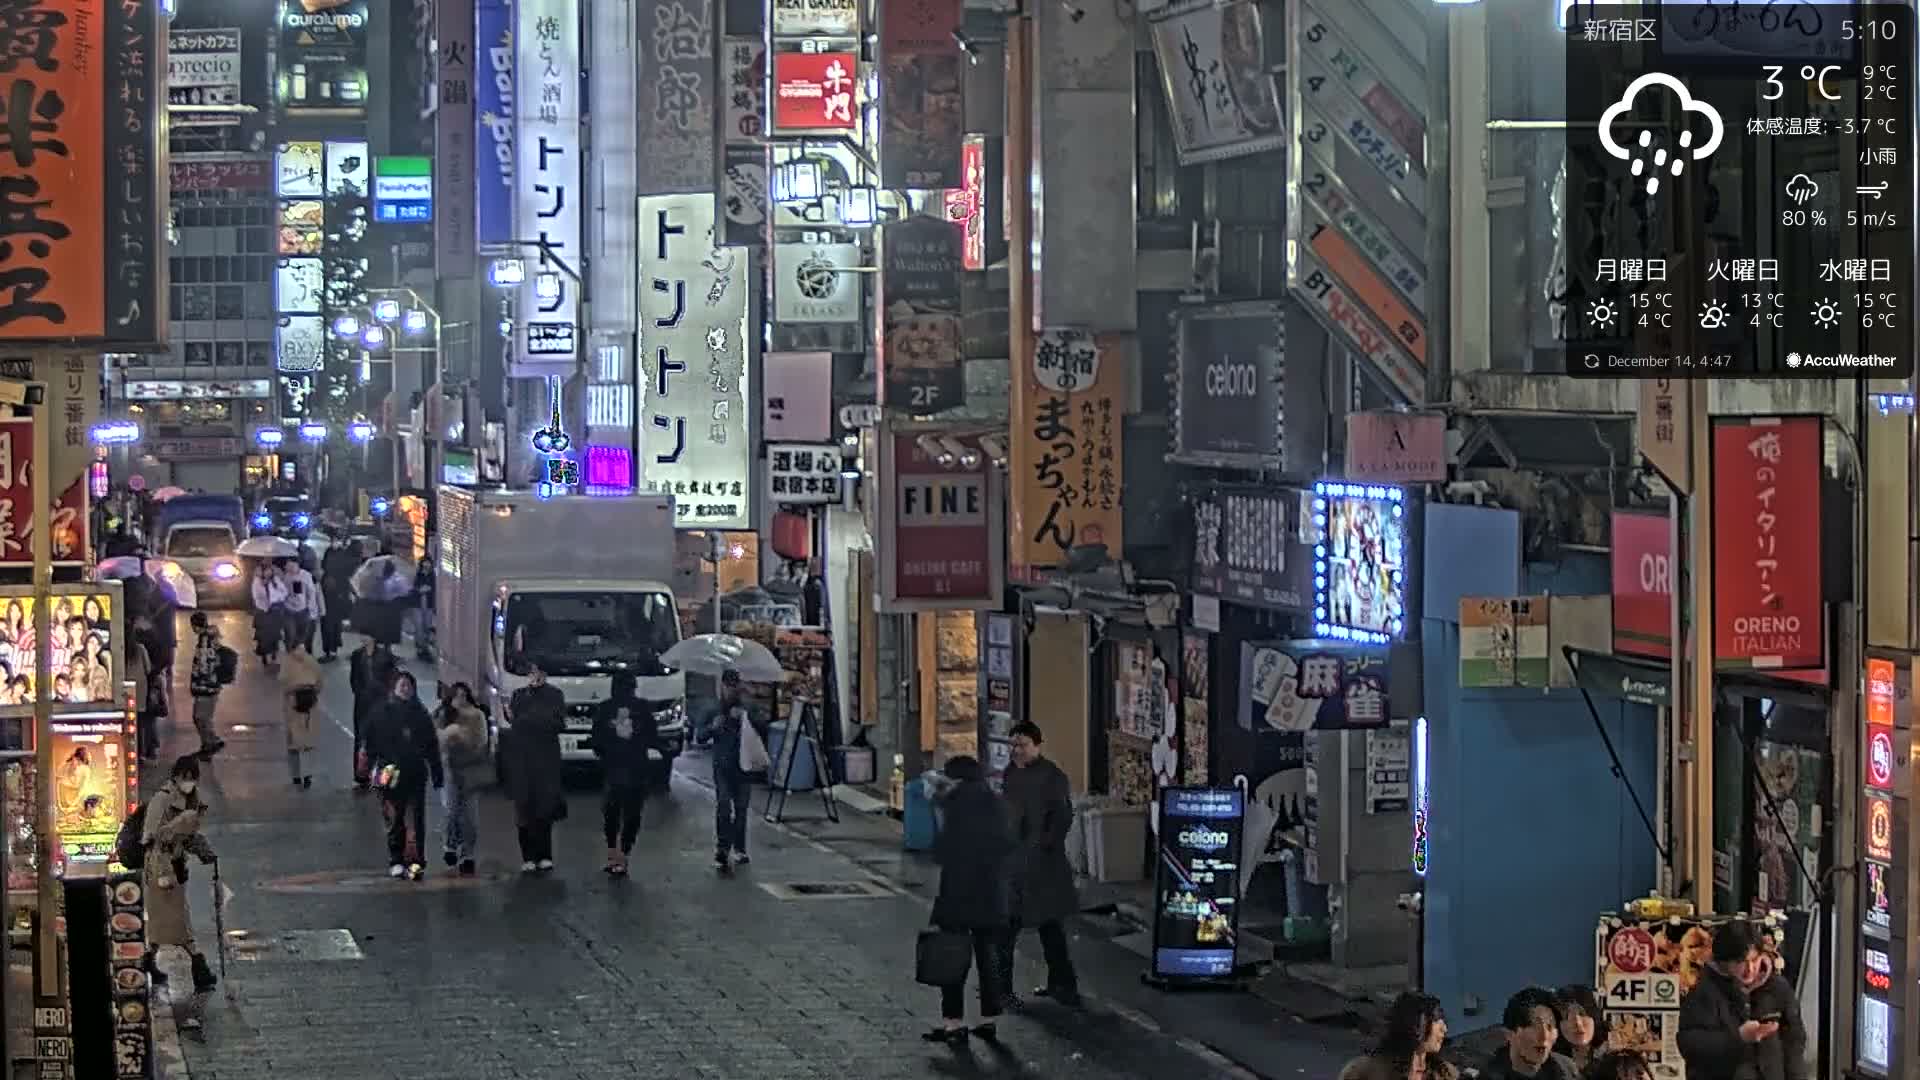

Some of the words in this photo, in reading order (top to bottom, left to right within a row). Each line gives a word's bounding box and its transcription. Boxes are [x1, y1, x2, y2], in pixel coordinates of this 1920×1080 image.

[288, 13, 362, 27] auralume
[1306, 23, 1328, 43] 5
[1307, 76, 1326, 92] 4
[1307, 123, 1327, 143] 3
[1305, 173, 1326, 195] 2
[533, 136, 566, 313] トントン
[1303, 269, 1332, 299] B1
[653, 209, 688, 464] トントン
[63, 358, 85, 446] 通り一番街
[911, 387, 940, 405] 2F
[772, 451, 837, 473] 酒場心
[1033, 397, 1079, 550] まっちゃん
[772, 476, 836, 494] 新宿本店
[904, 486, 979, 515] FINE
[1748, 431, 1782, 605] 俺のイタリアン
[1639, 552, 1672, 594] OR
[1734, 616, 1800, 633] ORENO
[1733, 635, 1801, 651] ITALIAN
[1302, 656, 1388, 722] 麻雀
[1611, 979, 1646, 1001] 4F
[35, 1008, 65, 1027] NERO
[40, 1039, 67, 1057] NERO
